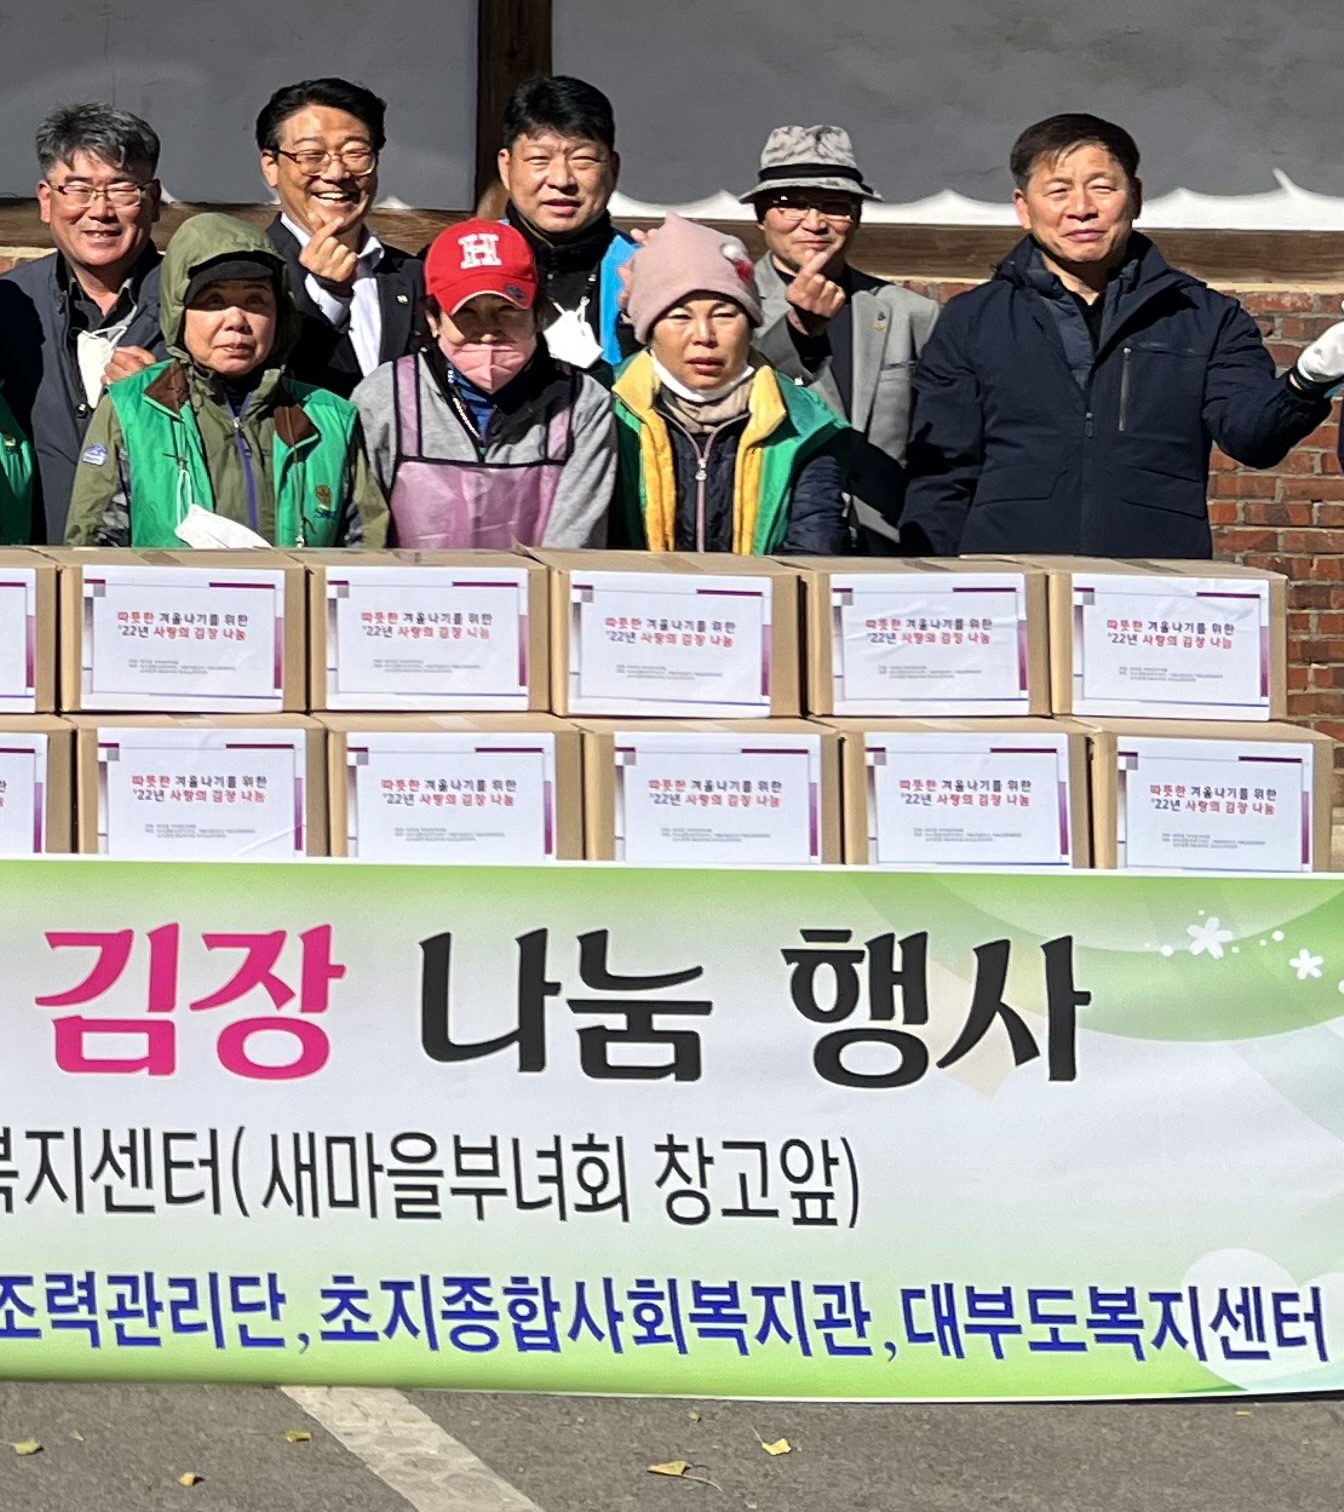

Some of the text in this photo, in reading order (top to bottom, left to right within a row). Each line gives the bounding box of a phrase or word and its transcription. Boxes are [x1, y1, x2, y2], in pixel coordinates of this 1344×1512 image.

[457, 233, 502, 269] H
[35, 922, 346, 1080] 김장
[418, 927, 713, 1082] 나눔
[780, 929, 1092, 1089] 행사
[654, 1133, 859, 1229] 창고앞)
